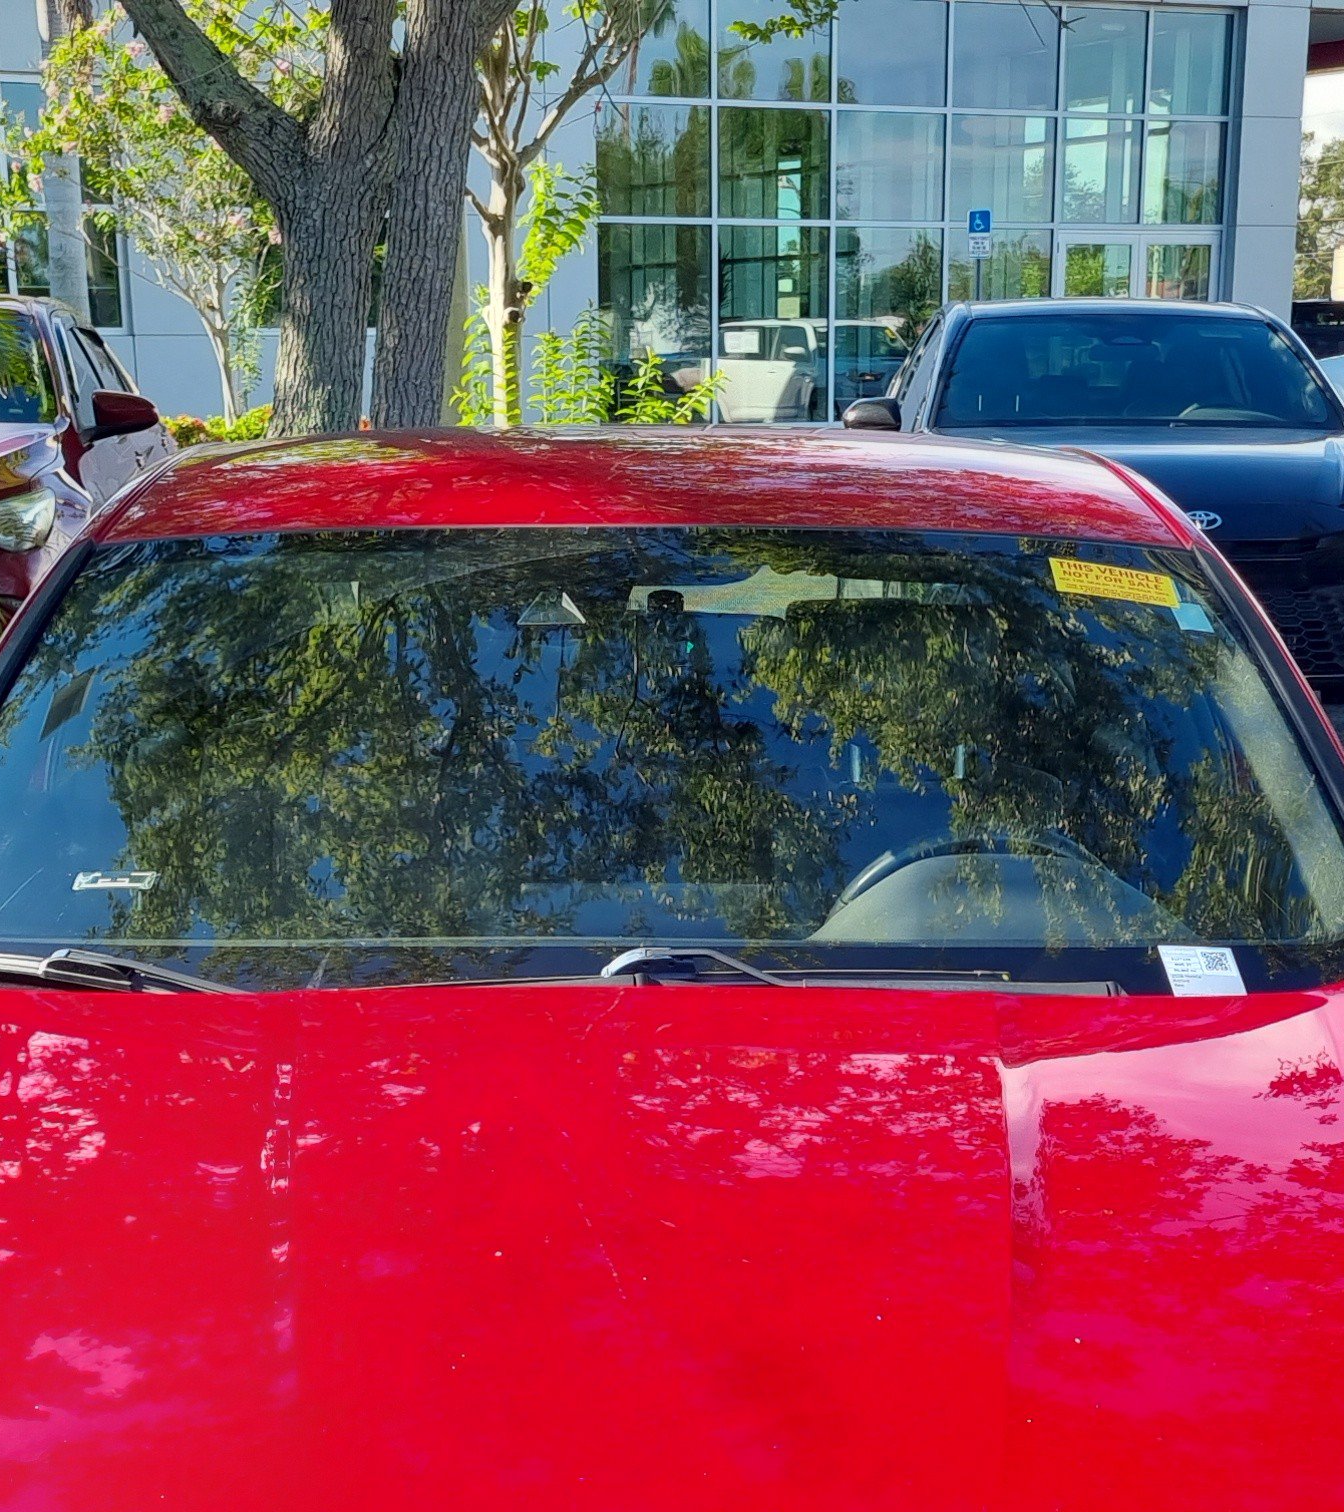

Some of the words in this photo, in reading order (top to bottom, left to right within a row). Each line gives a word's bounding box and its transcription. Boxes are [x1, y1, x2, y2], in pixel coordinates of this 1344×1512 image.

[1057, 561, 1093, 573] THIS
[1096, 566, 1164, 584] VEHICLE
[1062, 570, 1089, 579] NOT
[1096, 575, 1123, 584] FOR
[1128, 579, 1163, 591] SALE
